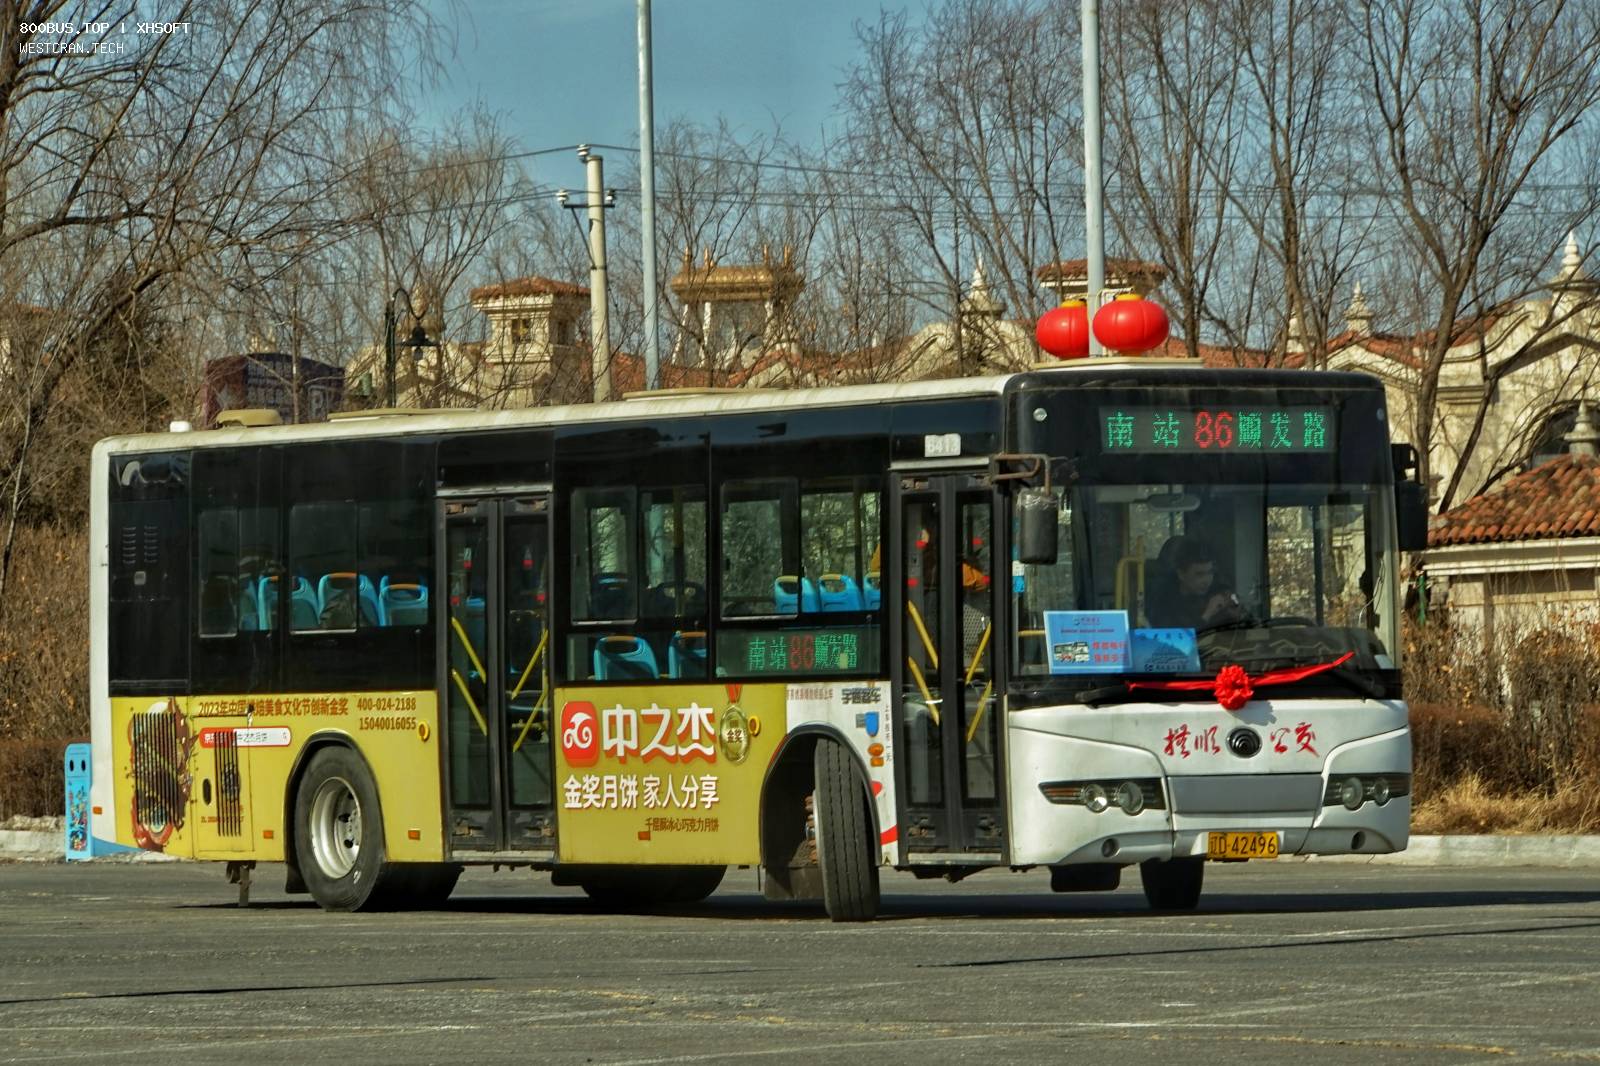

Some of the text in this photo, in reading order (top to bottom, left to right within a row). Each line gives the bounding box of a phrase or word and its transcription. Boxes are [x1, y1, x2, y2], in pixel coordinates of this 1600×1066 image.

[1107, 412, 1180, 448] 南站
[1194, 411, 1233, 448] 86
[789, 634, 814, 671] 86
[357, 697, 417, 711] 400-024-2188
[359, 716, 417, 731] 15040016055
[602, 702, 717, 762] 中之杰
[563, 774, 719, 809] 金奖月饼 家人分享
